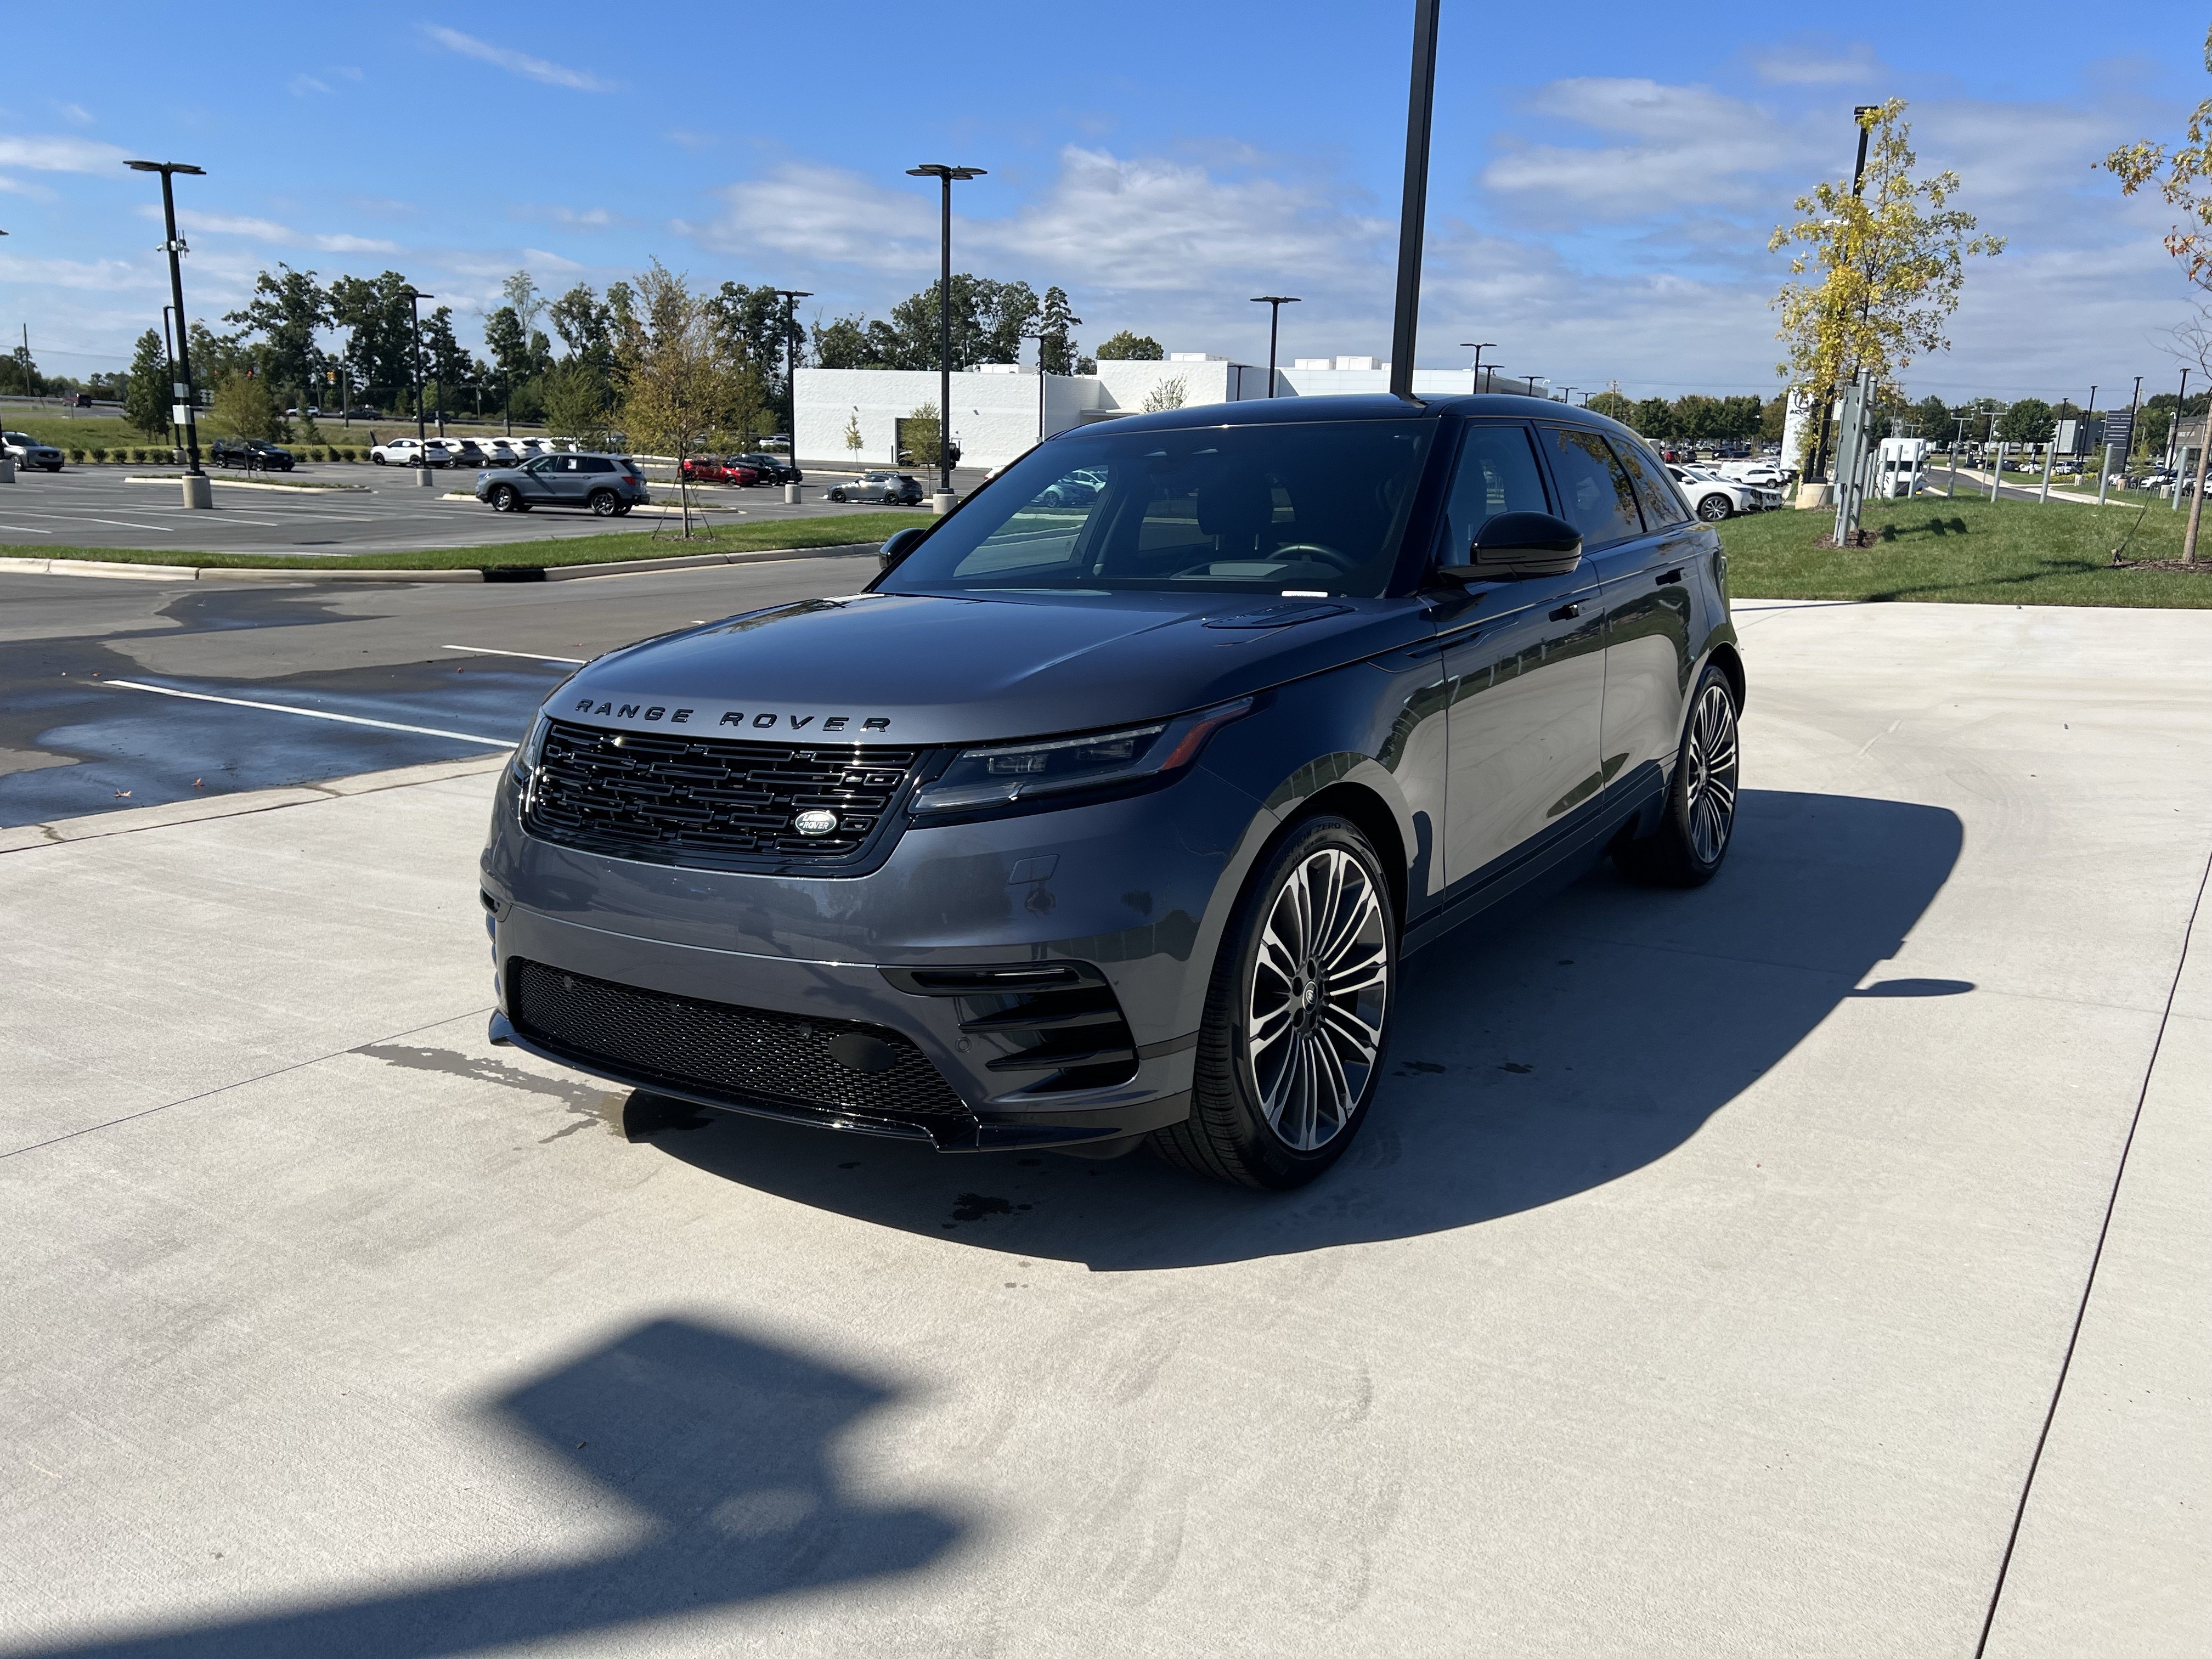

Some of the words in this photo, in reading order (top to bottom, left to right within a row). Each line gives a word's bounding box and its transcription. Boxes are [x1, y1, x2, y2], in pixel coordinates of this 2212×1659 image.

[575, 699, 694, 723] RANGE
[719, 712, 891, 732] ROVER
[802, 814, 830, 822] LA
[1316, 822, 1341, 831] ZERO
